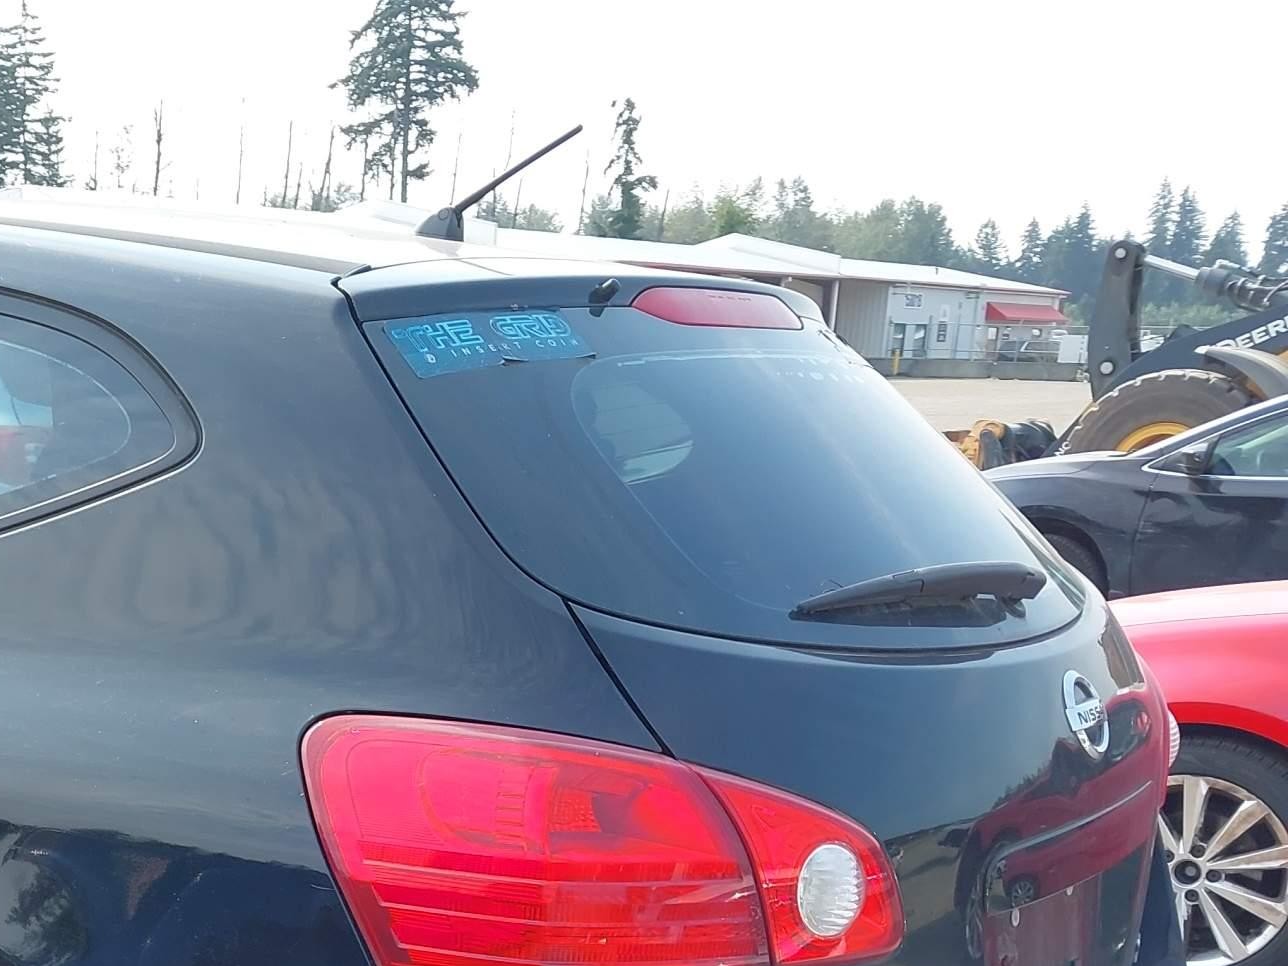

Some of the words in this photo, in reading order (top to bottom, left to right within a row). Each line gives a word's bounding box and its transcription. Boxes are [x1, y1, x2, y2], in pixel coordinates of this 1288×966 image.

[392, 319, 484, 353] THE
[490, 314, 571, 339] GRID
[450, 341, 521, 358] INSERT
